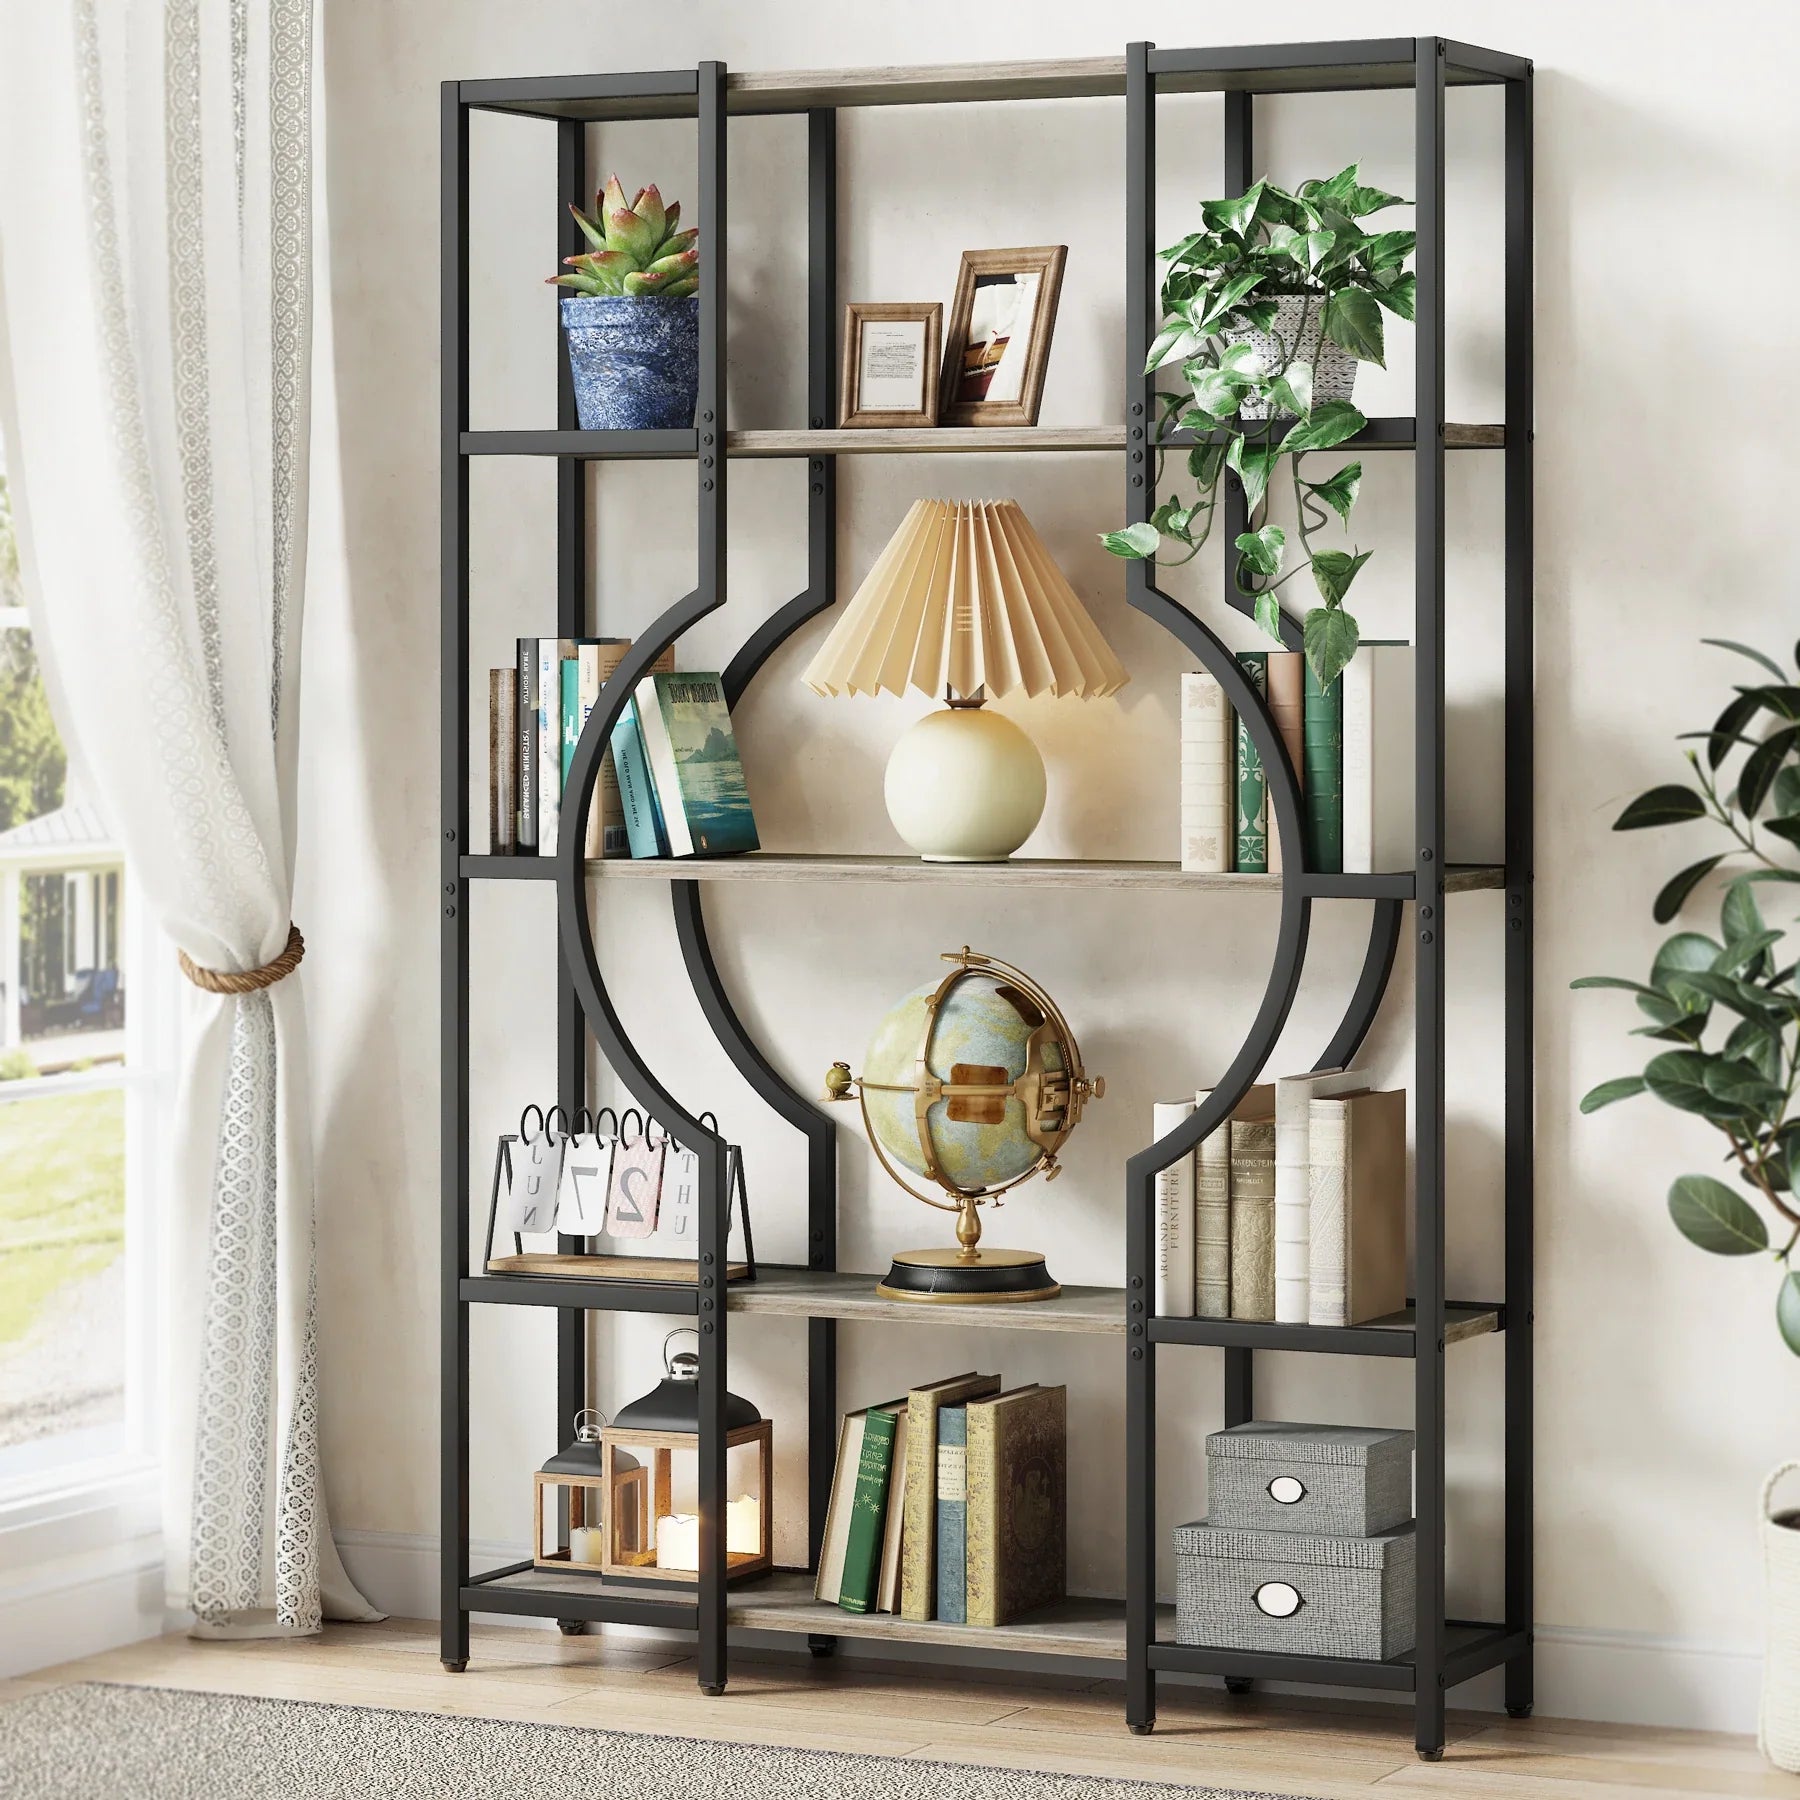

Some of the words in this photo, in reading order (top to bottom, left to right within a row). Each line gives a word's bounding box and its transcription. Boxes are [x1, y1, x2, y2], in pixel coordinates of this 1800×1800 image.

[1160, 1187, 1169, 1217] THE
[1170, 1168, 1180, 1250] FURNITURE
[1160, 1222, 1169, 1281] AROUND
